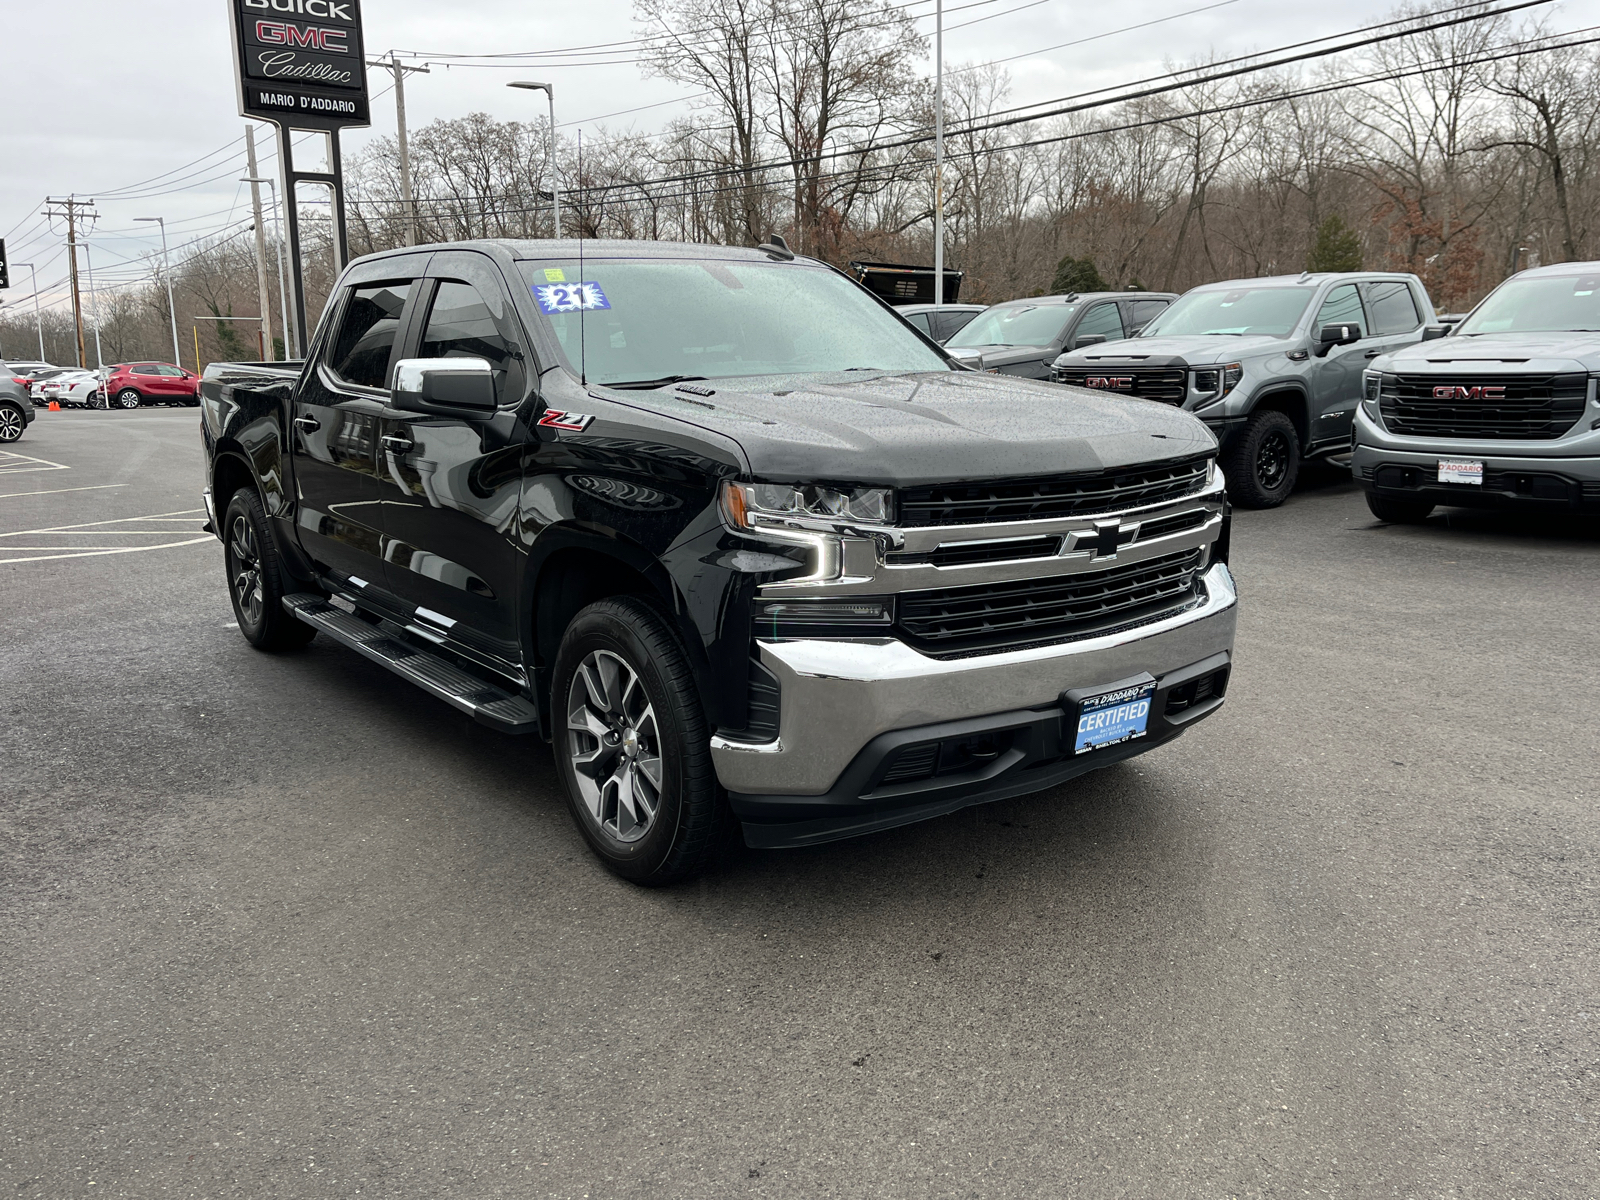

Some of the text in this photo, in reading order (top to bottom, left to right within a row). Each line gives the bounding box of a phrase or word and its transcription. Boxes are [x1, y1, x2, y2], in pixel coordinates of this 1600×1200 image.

[256, 20, 348, 53] GMC
[258, 51, 351, 83] Cadillac
[260, 92, 356, 113] MARIO D'ADDARIO
[553, 288, 587, 306] 21
[1086, 377, 1133, 389] GMC
[1433, 386, 1507, 400] GMC
[537, 408, 597, 434] Z71
[1438, 463, 1483, 473] D'ADDARIO
[1100, 687, 1139, 705] D'ADDARIO
[1078, 701, 1149, 733] CERTIFIED
[1085, 732, 1108, 742] CHEVROLET
[1100, 726, 1116, 734] BACKED
